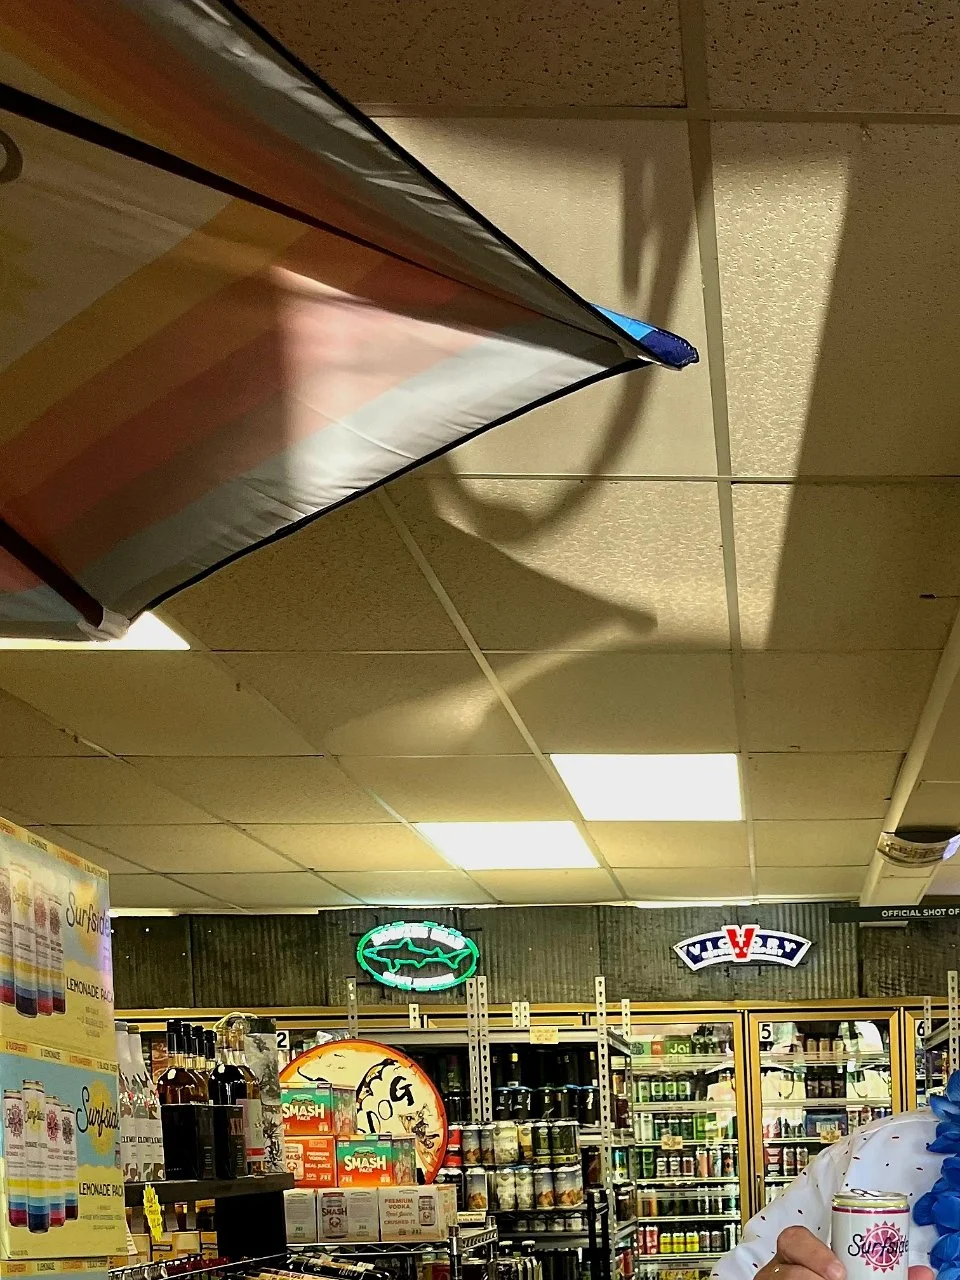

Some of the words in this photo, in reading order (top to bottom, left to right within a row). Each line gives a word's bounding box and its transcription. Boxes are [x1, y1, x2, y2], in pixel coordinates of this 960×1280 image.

[881, 909, 921, 917] OFFICIAL
[922, 908, 946, 916] SHOT
[66, 976, 99, 1000] LEMONADE
[761, 1023, 772, 1040] 5
[276, 1032, 287, 1049] 2
[282, 1102, 325, 1118] SMASH
[344, 1155, 387, 1172] SMASH
[79, 1181, 111, 1197] LEMONADE
[847, 1234, 909, 1257] Surfside
